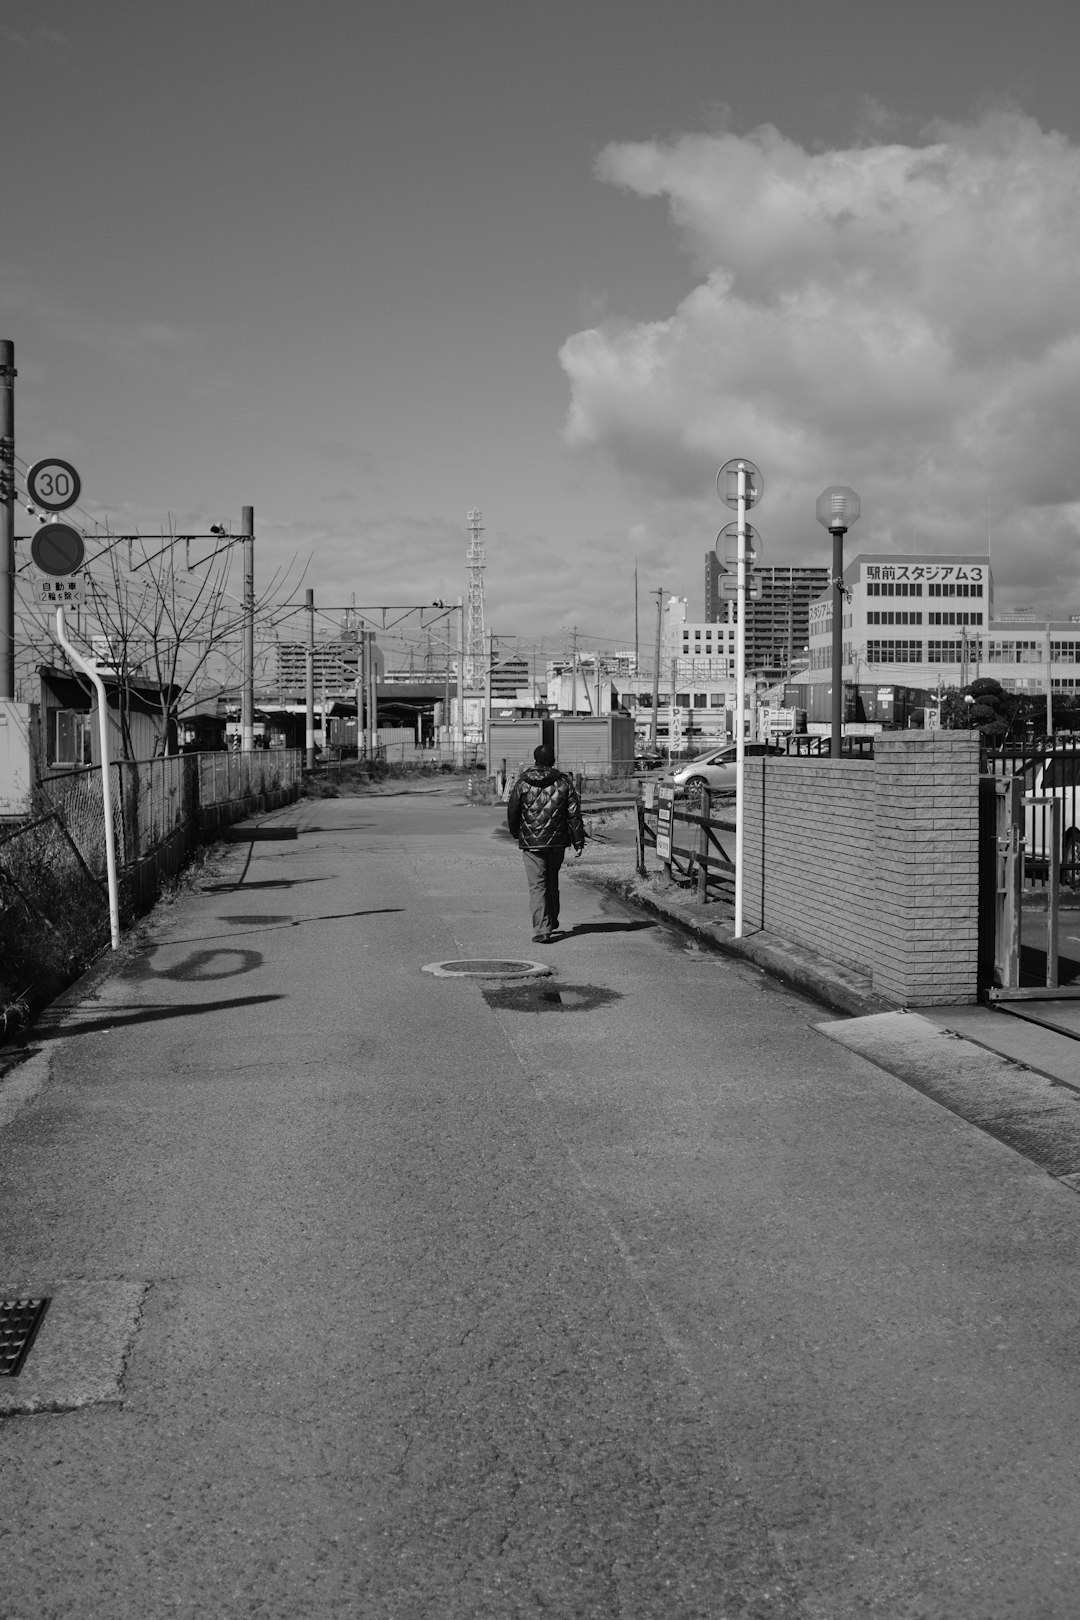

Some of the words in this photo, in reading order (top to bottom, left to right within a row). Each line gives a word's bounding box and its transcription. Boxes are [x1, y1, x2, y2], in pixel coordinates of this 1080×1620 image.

[40, 473, 69, 496] 30
[866, 565, 983, 582] 駅前スタジアム3
[42, 582, 76, 591] 自動車
